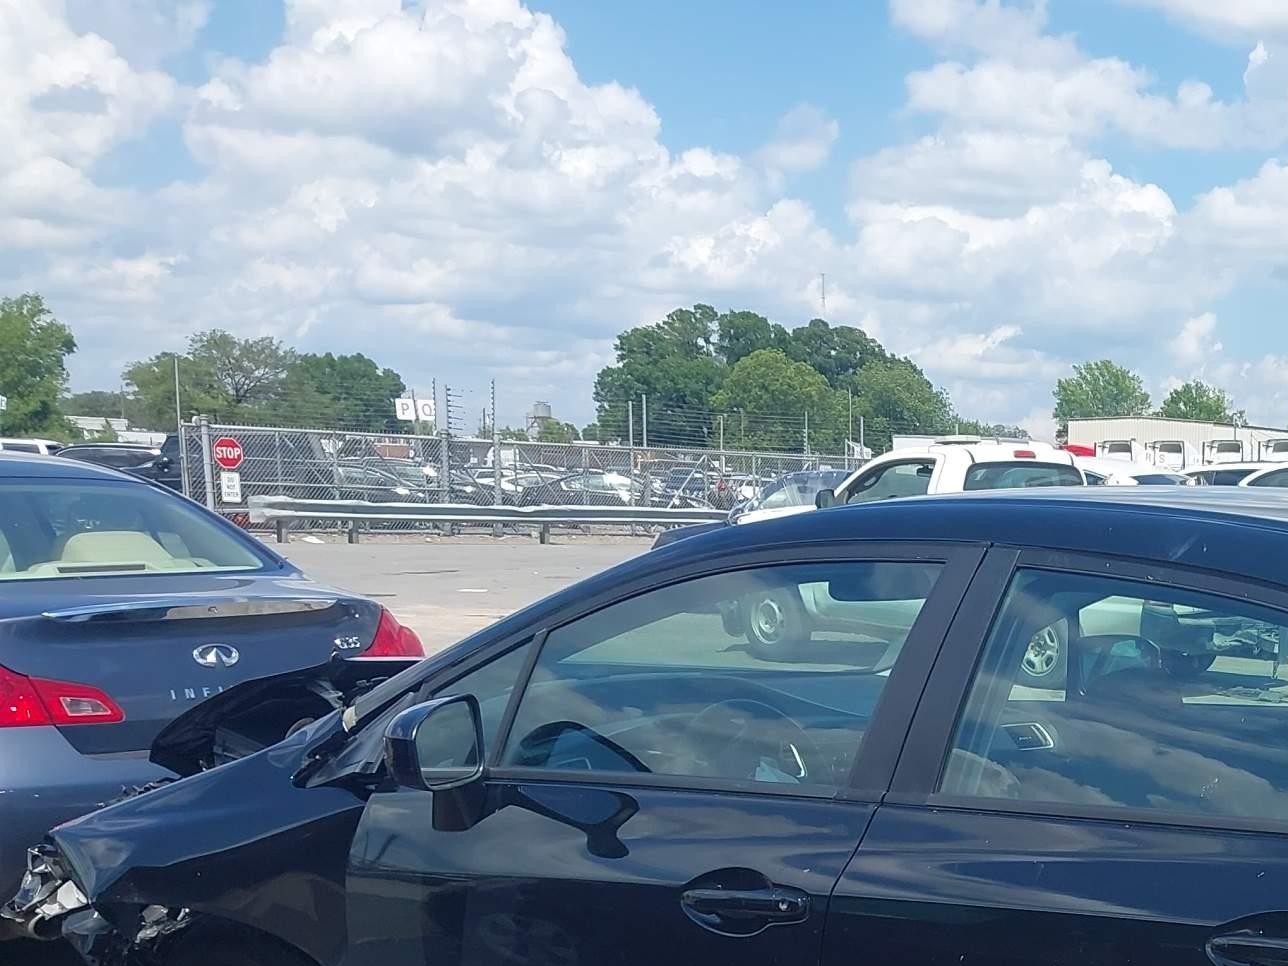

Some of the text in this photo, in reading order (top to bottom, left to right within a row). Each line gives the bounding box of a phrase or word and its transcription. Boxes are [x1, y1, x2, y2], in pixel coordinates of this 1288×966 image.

[401, 402, 409, 416] P
[216, 446, 240, 459] STOP
[170, 685, 233, 700] INFI
